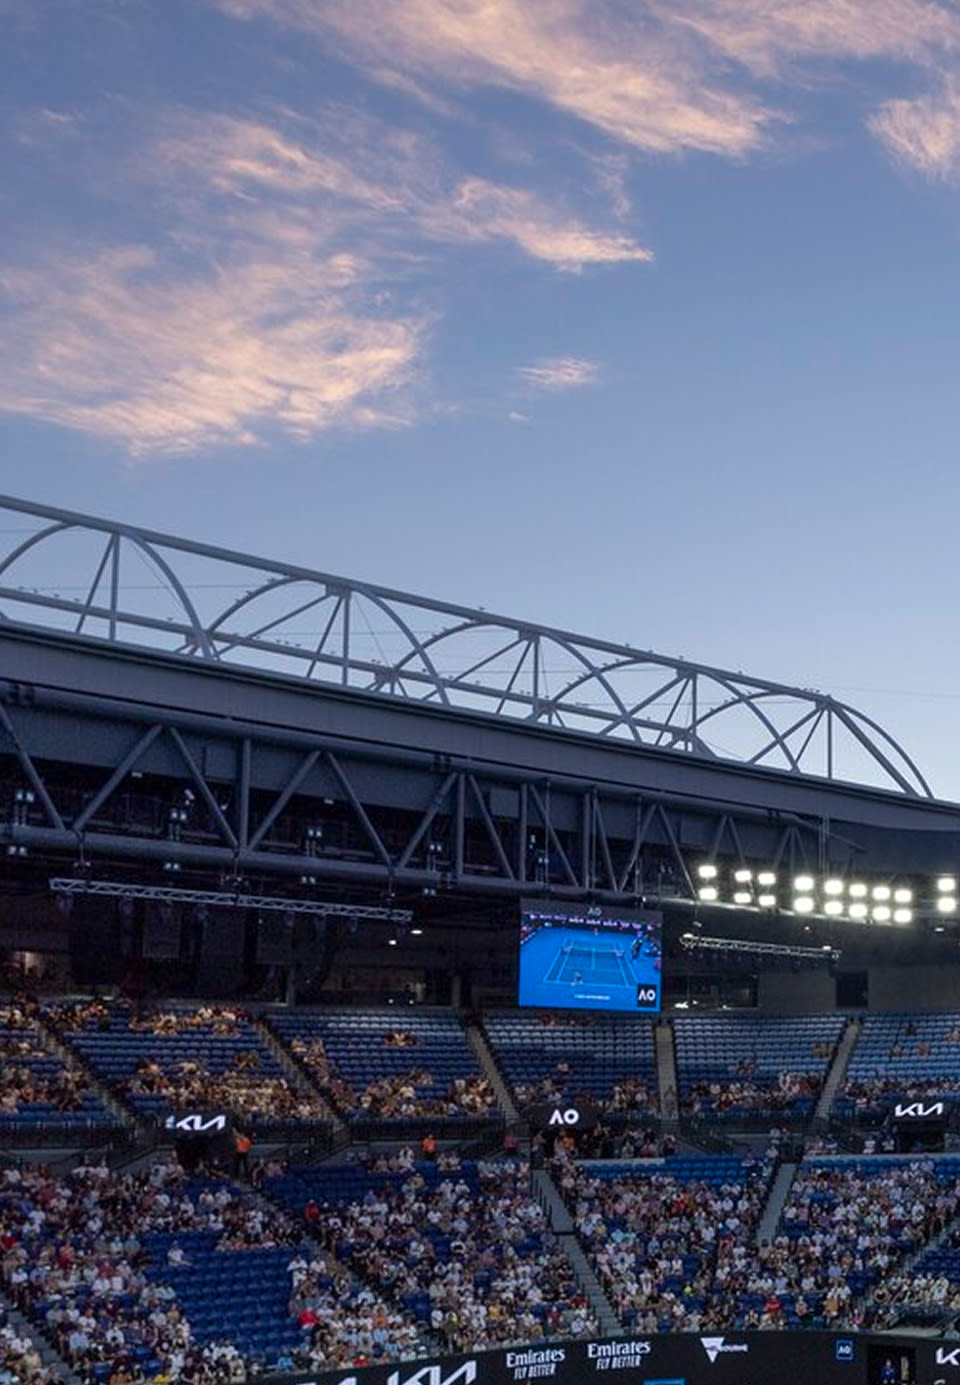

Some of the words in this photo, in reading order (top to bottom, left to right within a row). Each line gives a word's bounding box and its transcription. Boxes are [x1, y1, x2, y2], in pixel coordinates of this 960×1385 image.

[638, 989, 656, 1001] AO
[549, 1108, 579, 1125] AO
[894, 1102, 944, 1117] KIA
[506, 1349, 566, 1368] Emirates
[588, 1341, 650, 1359] Emirates
